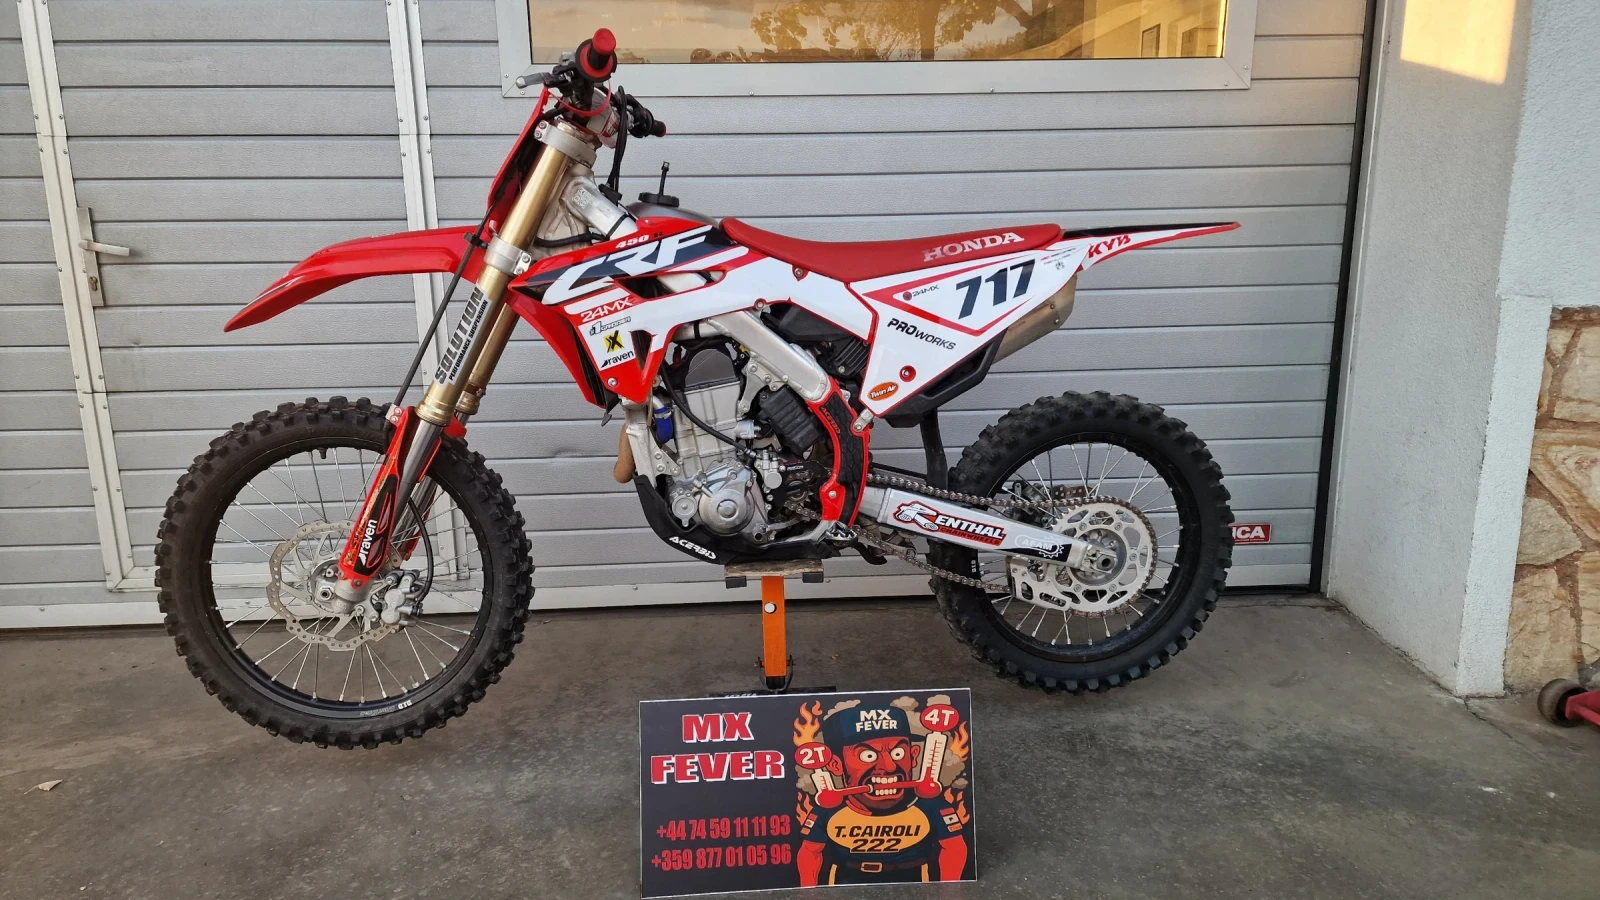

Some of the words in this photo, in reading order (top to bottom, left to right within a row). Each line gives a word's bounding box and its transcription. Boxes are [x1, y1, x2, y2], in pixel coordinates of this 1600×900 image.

[615, 234, 650, 249] 450
[921, 232, 1025, 262] HONDA
[1088, 235, 1131, 259] KYB
[541, 224, 713, 305] CRF
[912, 284, 939, 297] 24MX
[955, 258, 1036, 320] 717
[580, 296, 633, 323] 24MX
[434, 286, 484, 385] SOLUTION
[448, 338, 472, 381] PERFORMANCE
[468, 299, 489, 339] SUSPENSION
[607, 350, 635, 365] raven
[870, 389, 886, 399] Twin
[886, 384, 897, 393] Air
[359, 519, 378, 555] raven
[681, 711, 755, 744] MX
[855, 719, 898, 733] FEVER
[859, 709, 892, 722] MX
[924, 708, 955, 726] 4T
[650, 750, 786, 785] FEVER
[799, 746, 826, 765] 2T
[656, 819, 687, 841] +44
[688, 818, 707, 840] 74
[709, 817, 731, 839] 59
[733, 816, 749, 837] 11
[751, 815, 767, 837] 11
[769, 814, 791, 836] 93
[651, 848, 693, 872] +359
[695, 846, 723, 870] 877
[725, 845, 744, 868] 01
[746, 844, 768, 867] 05
[770, 843, 792, 865] 96
[850, 837, 902, 853] 222
